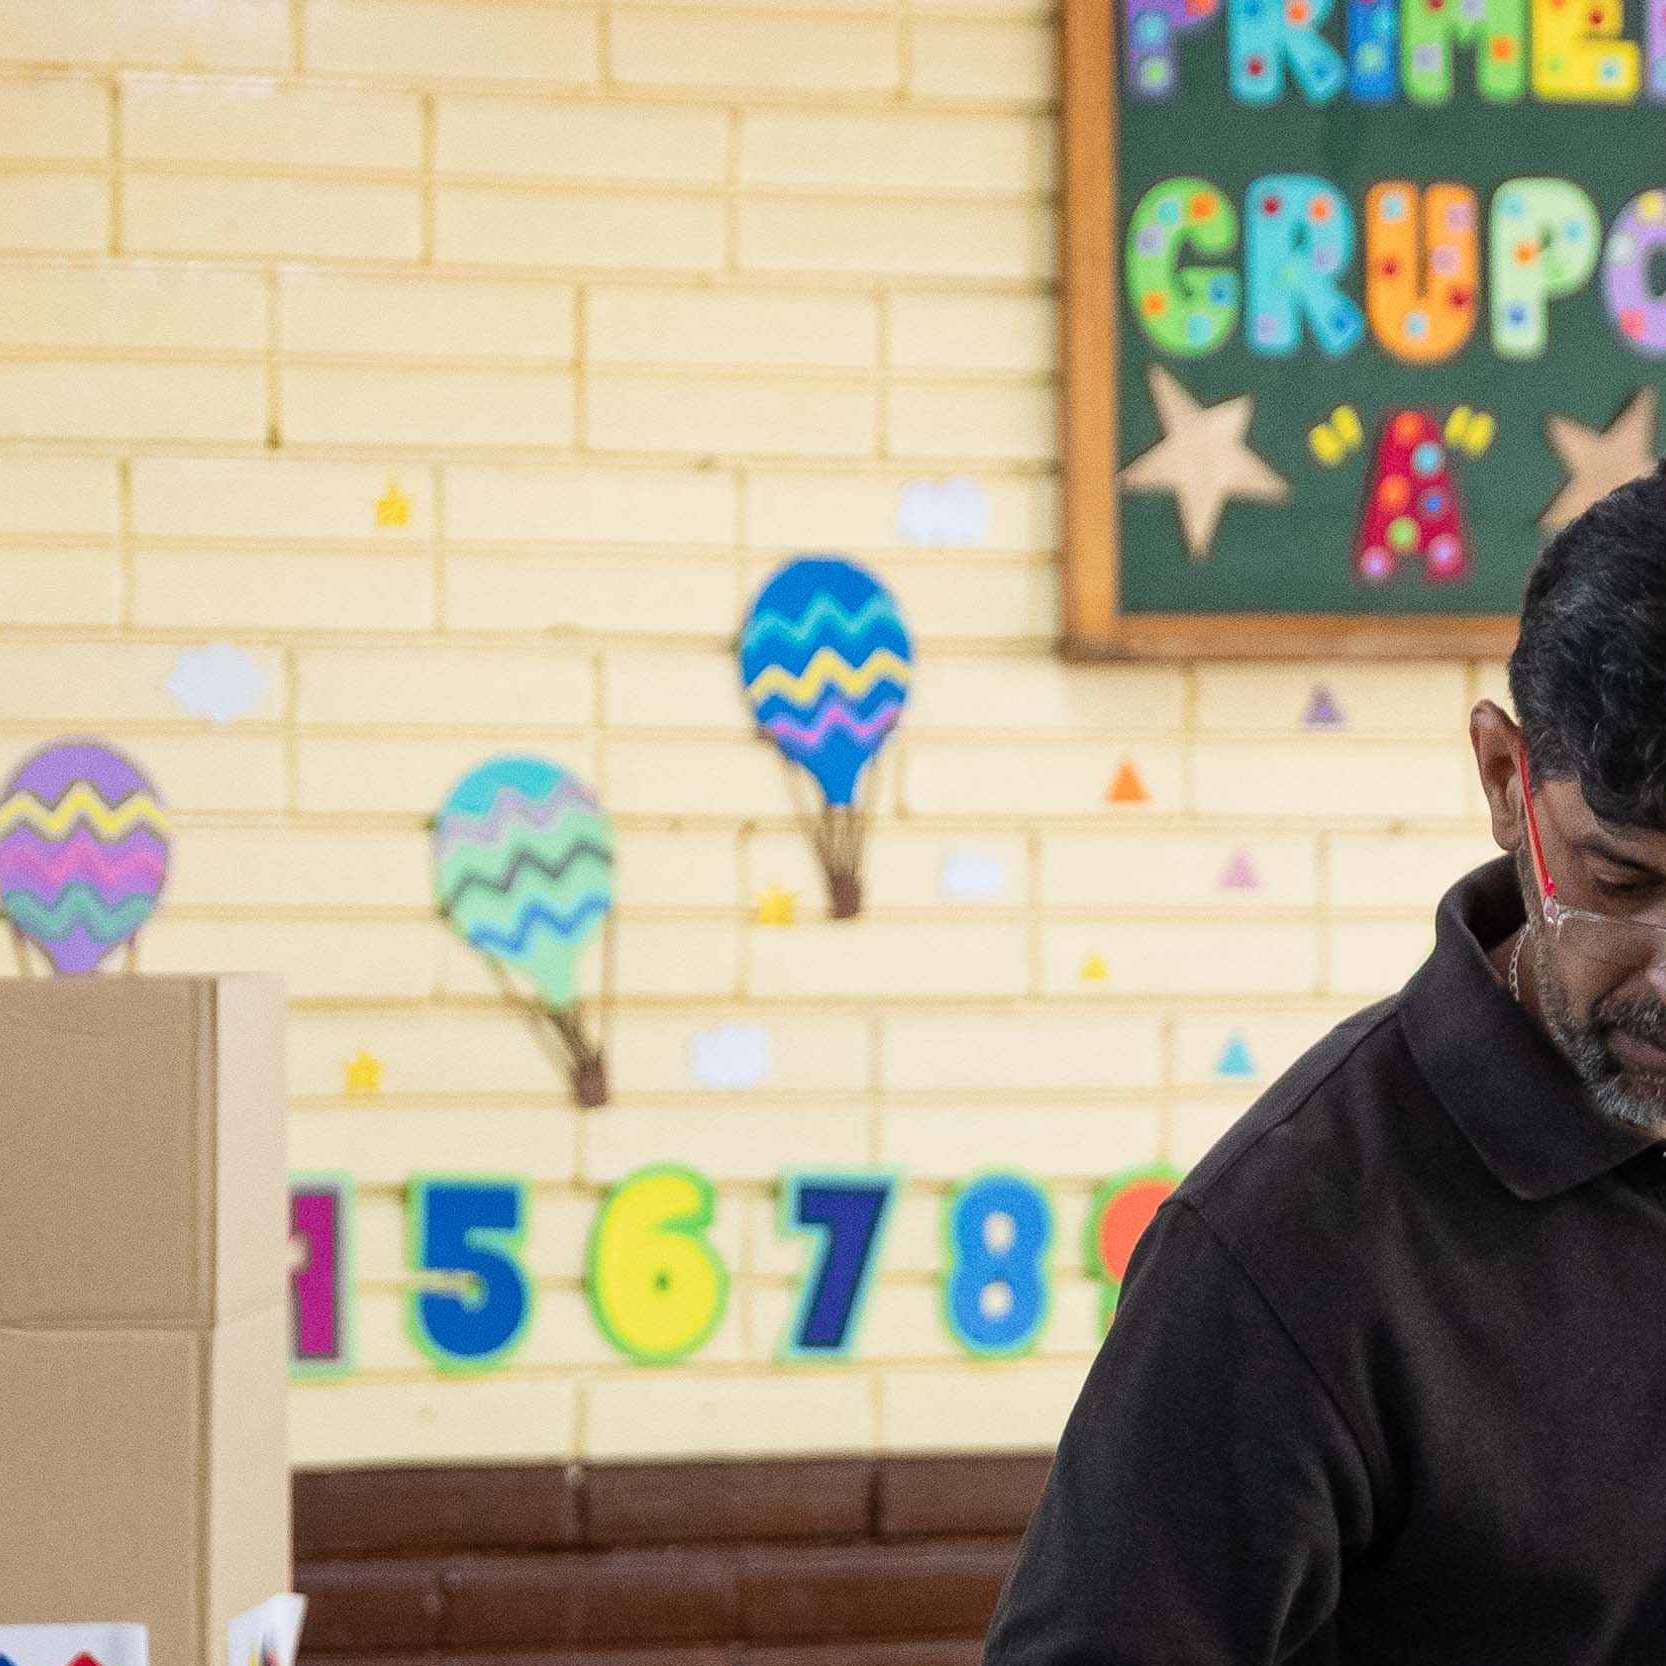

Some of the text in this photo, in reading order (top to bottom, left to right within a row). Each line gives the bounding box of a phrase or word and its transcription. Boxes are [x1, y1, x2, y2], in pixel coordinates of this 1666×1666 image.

[410, 1175, 534, 1367] 5
[594, 1167, 726, 1363] 6
[785, 1173, 898, 1356] 7
[944, 1170, 1053, 1358] 8
